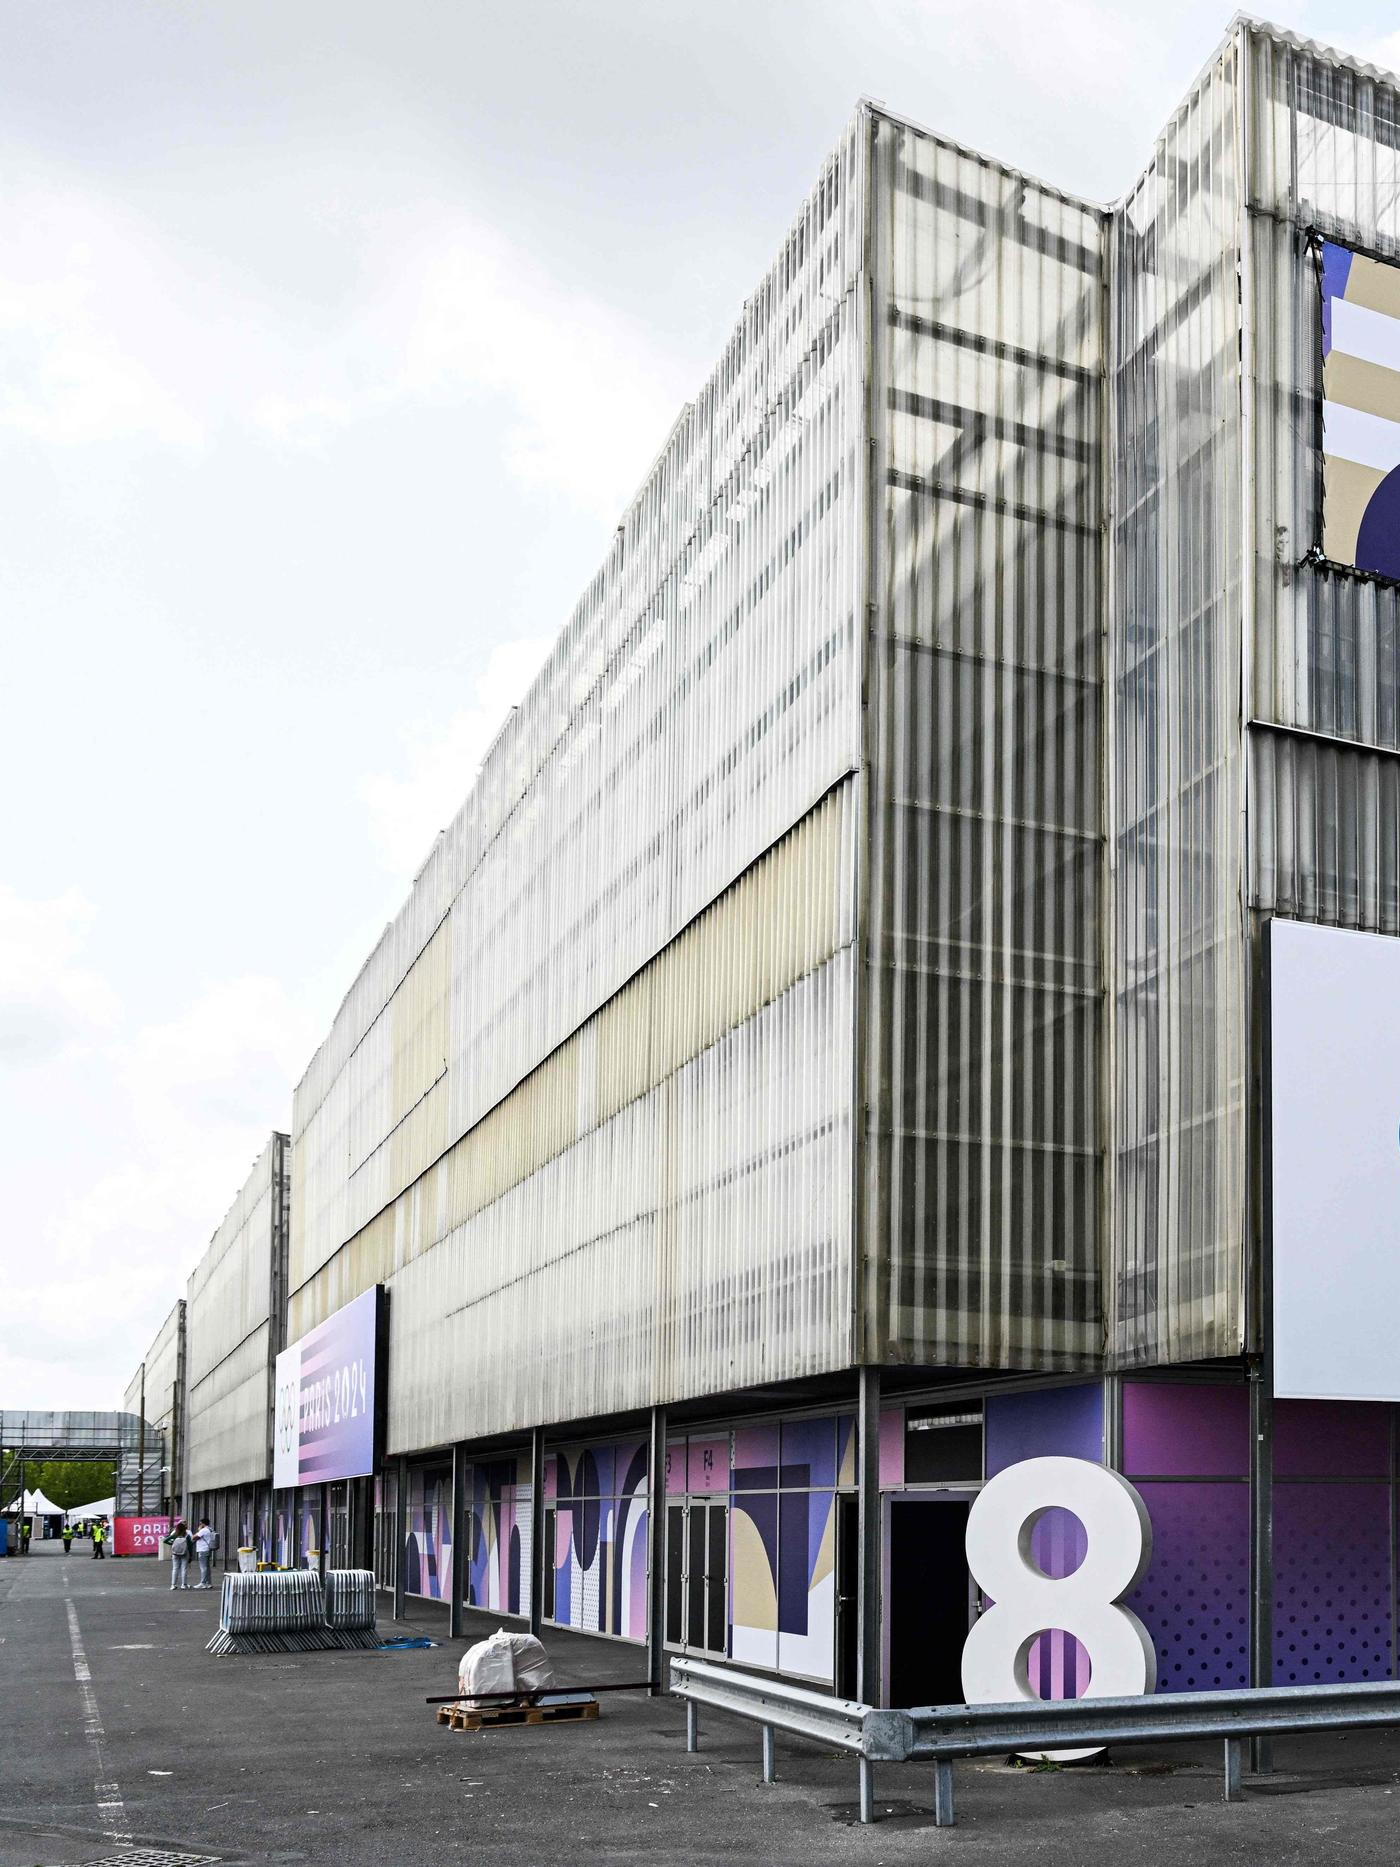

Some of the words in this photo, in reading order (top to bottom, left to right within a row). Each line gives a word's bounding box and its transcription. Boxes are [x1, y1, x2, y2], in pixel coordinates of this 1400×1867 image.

[334, 1358, 367, 1423] 2024
[703, 1450, 713, 1471] F4
[961, 1456, 1155, 1761] 8
